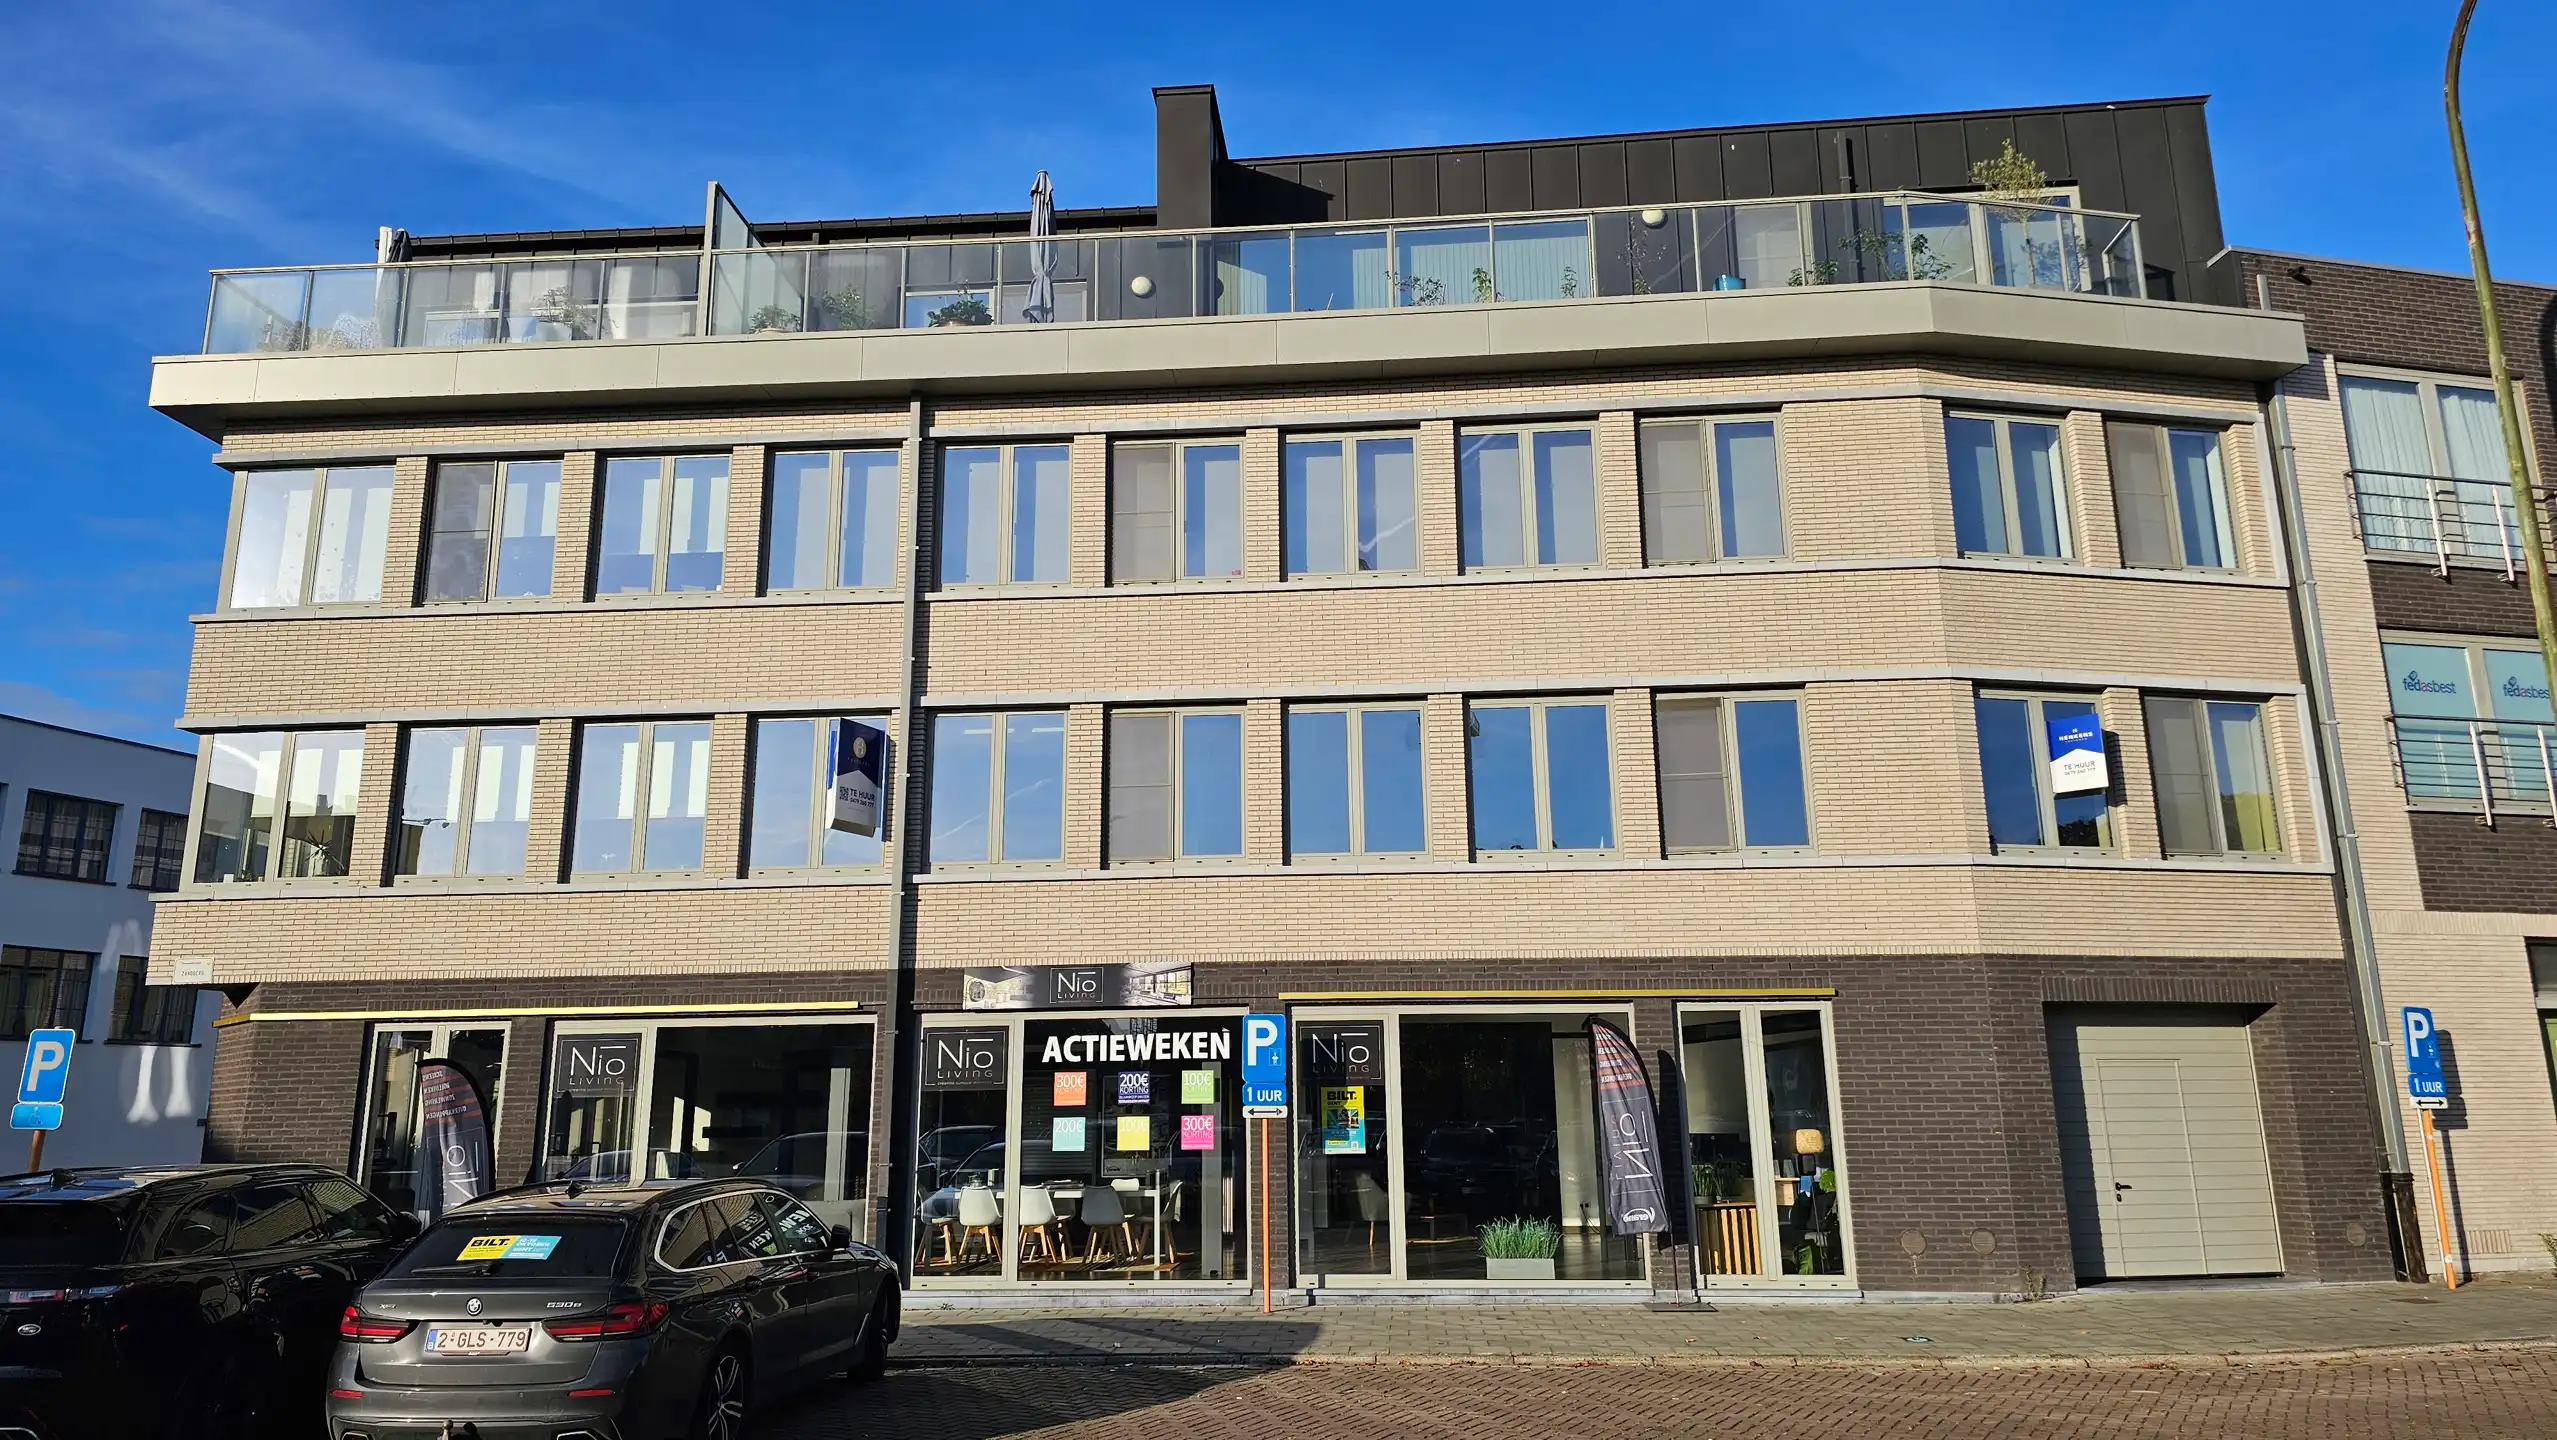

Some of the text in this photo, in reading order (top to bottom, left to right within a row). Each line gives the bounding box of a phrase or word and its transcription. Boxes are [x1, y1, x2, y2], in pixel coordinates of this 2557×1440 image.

[2403, 678, 2457, 694] fedasbest
[2503, 683, 2551, 699] fedasbes
[2074, 761, 2095, 769] HUUR
[850, 788, 875, 801] TE HUUR
[2406, 1011, 2430, 1058] P
[1042, 1031, 1231, 1063] ACTIEWEKEN
[1247, 1019, 1278, 1066] P
[26, 1041, 65, 1091] P
[1056, 1074, 1085, 1088] 300€
[1119, 1073, 1149, 1087] 200€
[1184, 1072, 1212, 1086] 100€
[2413, 1077, 2444, 1093] 1 UUR
[1119, 1086, 1149, 1094] KORTING
[1247, 1086, 1283, 1102] 1 UUR
[1326, 1090, 1357, 1101] BILT.
[1055, 1119, 1083, 1133] 200€
[1183, 1117, 1213, 1131] 300€
[471, 1238, 510, 1247] BILT.
